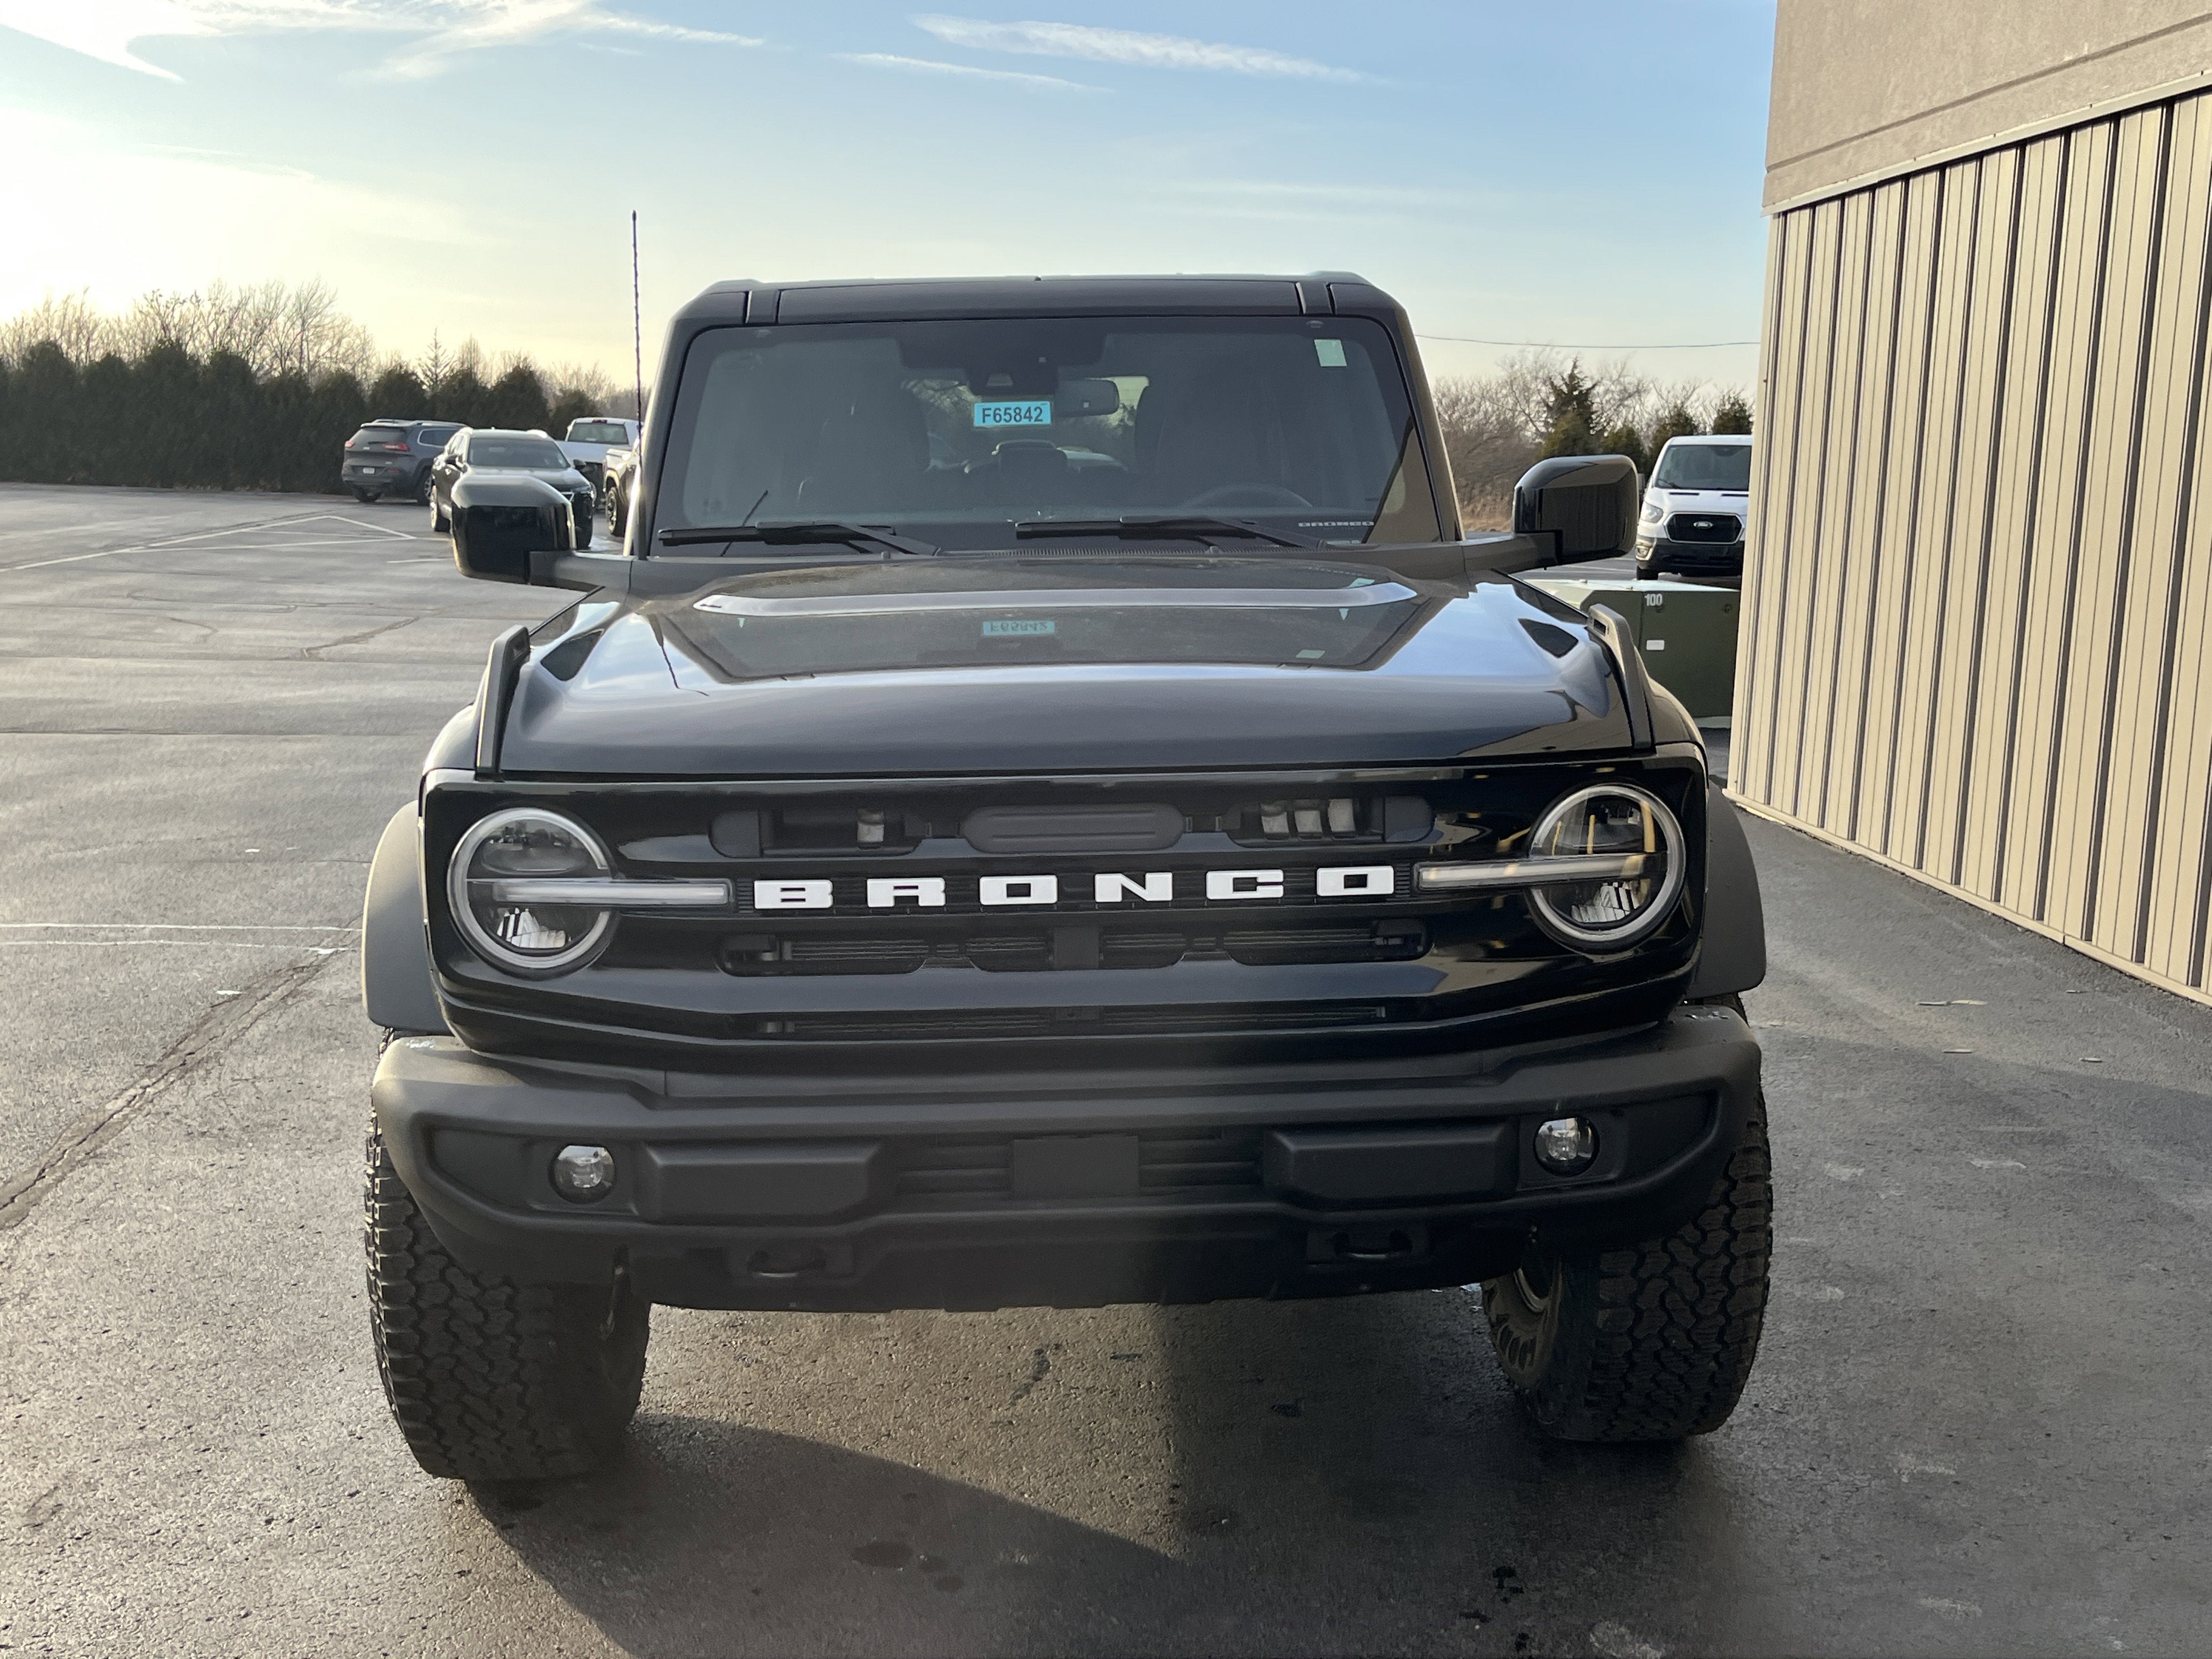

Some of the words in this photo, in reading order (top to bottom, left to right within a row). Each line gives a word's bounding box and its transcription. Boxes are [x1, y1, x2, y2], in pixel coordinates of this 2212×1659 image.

[981, 406, 1043, 424] F65842
[1644, 594, 1663, 606] 100
[753, 866, 1395, 910] BRONCO
